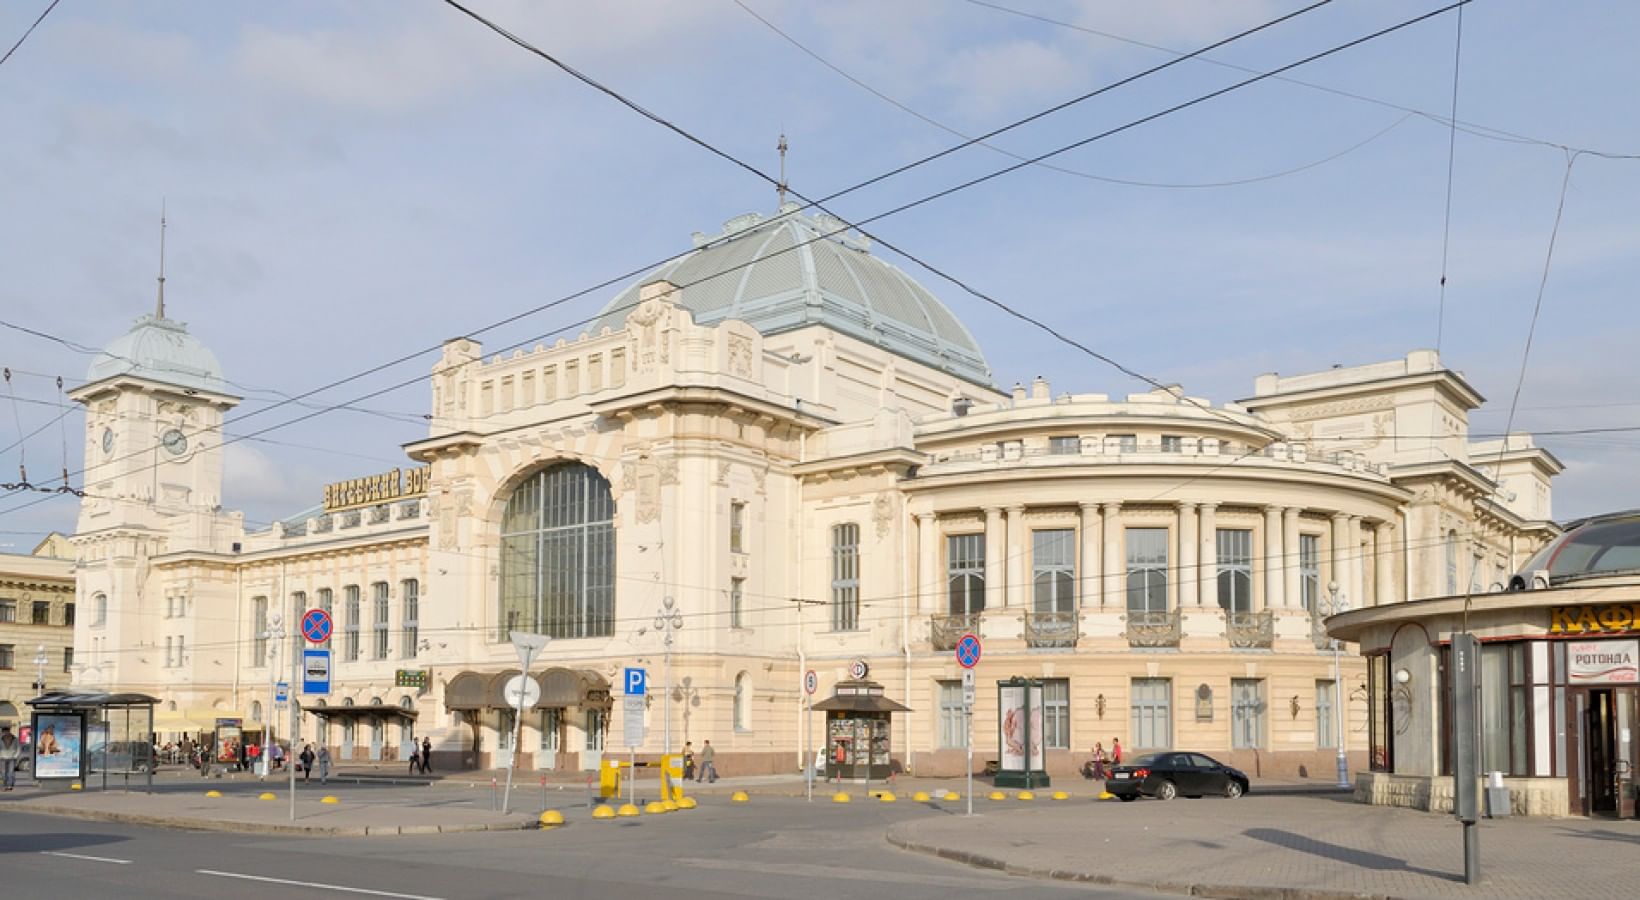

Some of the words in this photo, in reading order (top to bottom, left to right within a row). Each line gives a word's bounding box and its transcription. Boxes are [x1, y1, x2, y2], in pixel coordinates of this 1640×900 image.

[323, 467, 401, 510] ВИТЕБСКИЙ
[1575, 653, 1631, 665] РОТОНДА
[629, 670, 643, 693] P
